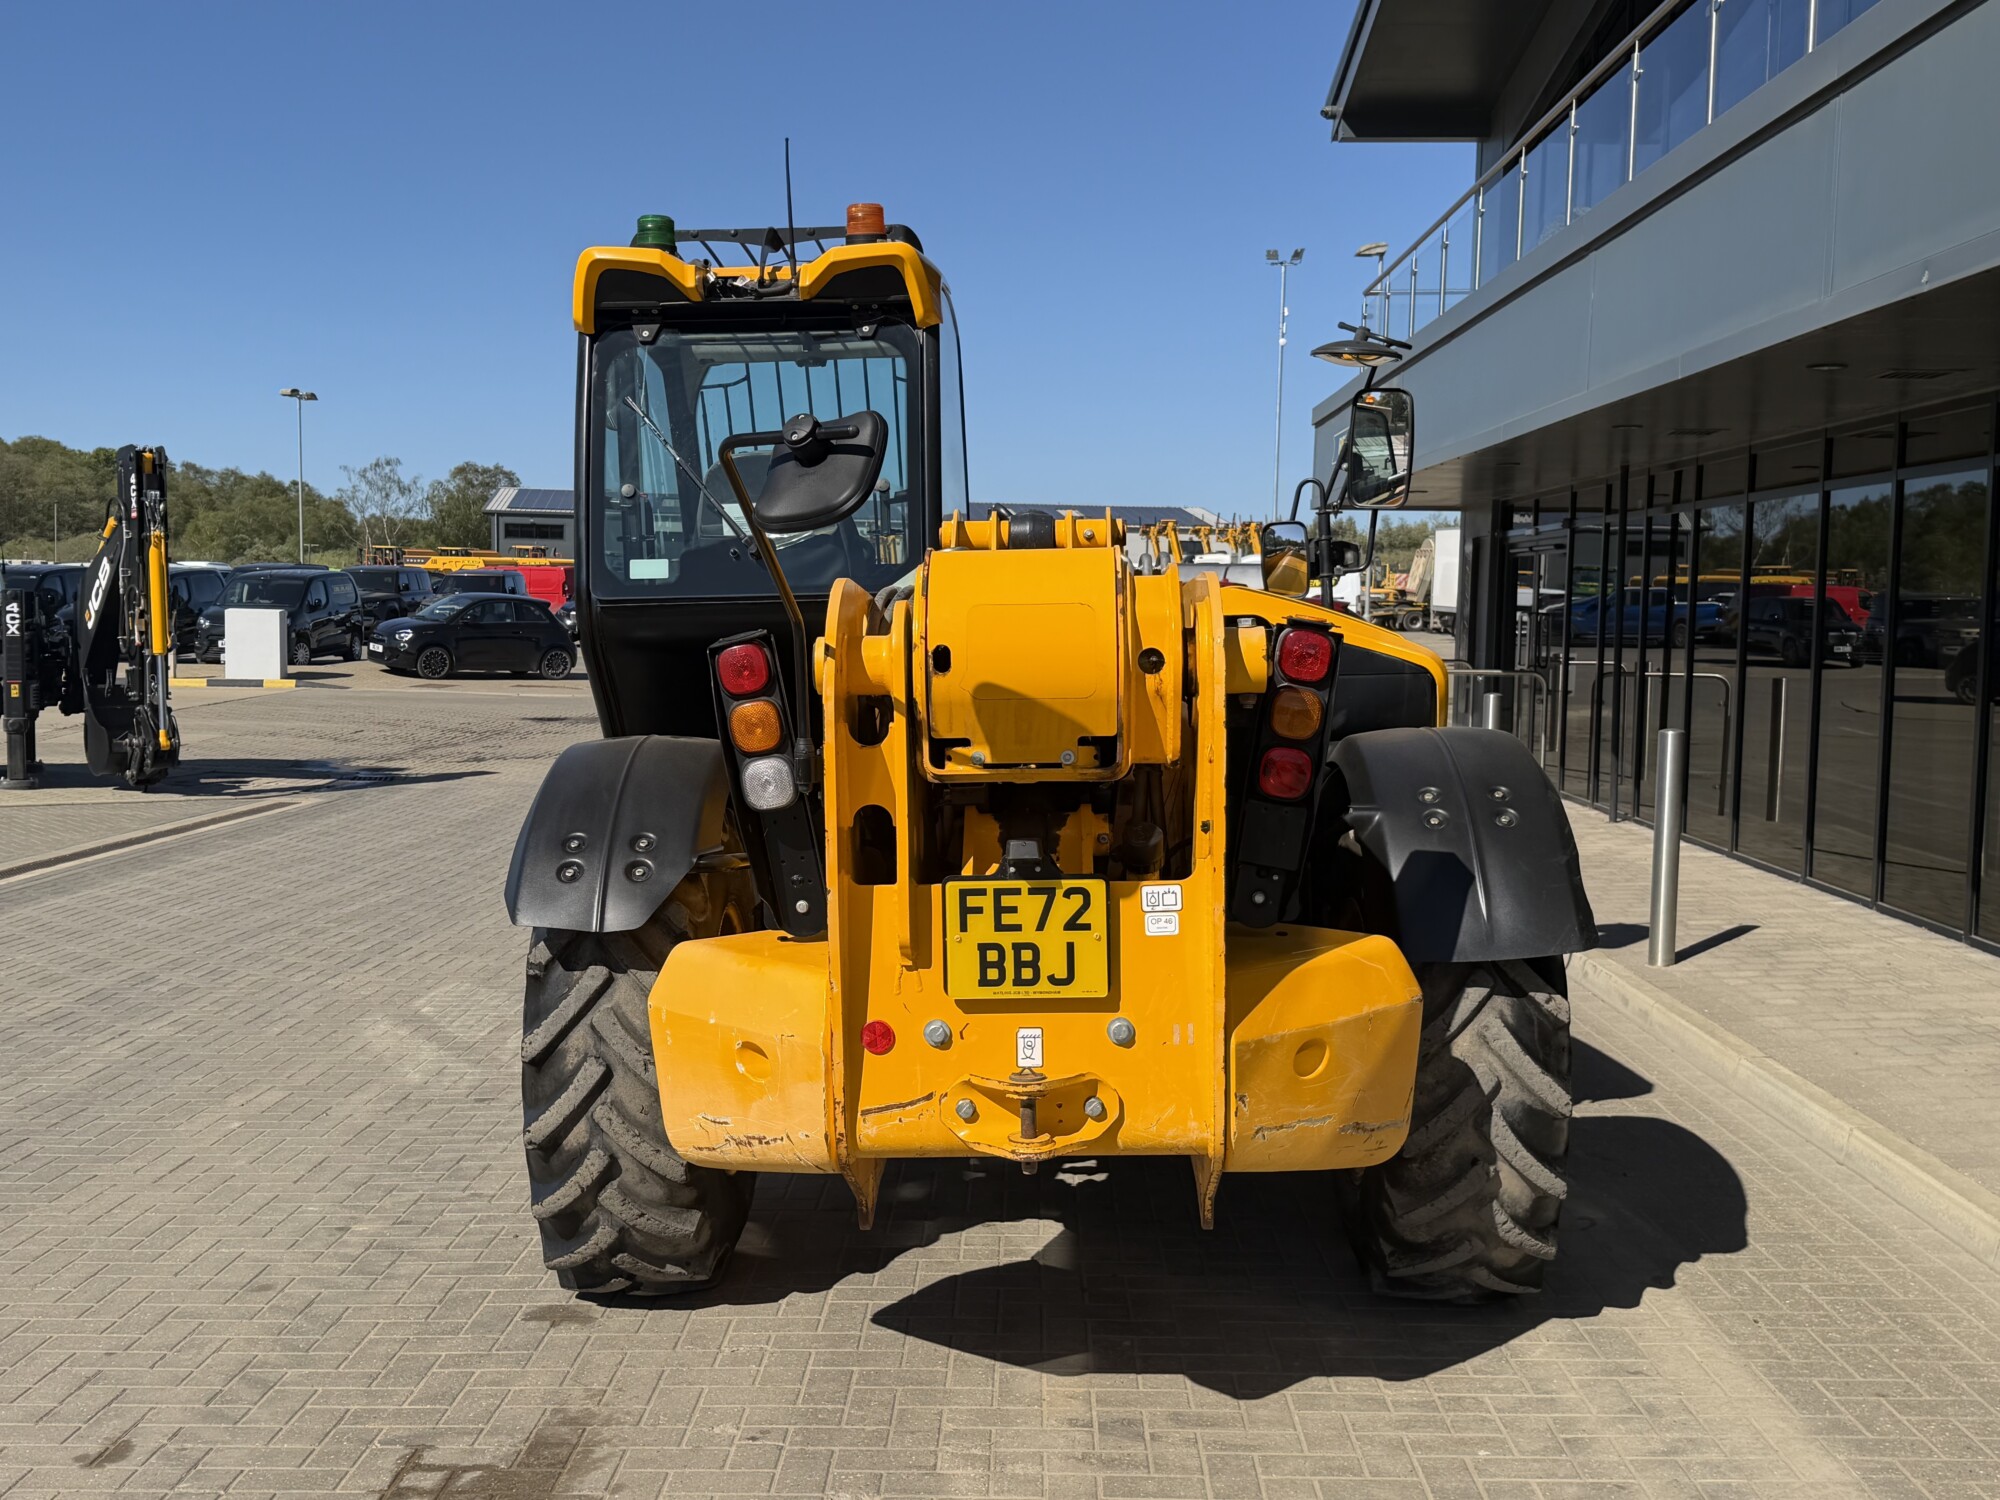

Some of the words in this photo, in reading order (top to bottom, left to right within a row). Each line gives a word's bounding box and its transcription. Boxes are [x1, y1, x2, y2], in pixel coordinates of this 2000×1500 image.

[87, 556, 111, 630] JCB
[5, 602, 21, 635] 4CX
[959, 887, 1091, 932] FE72
[977, 942, 1075, 987] BBJ
